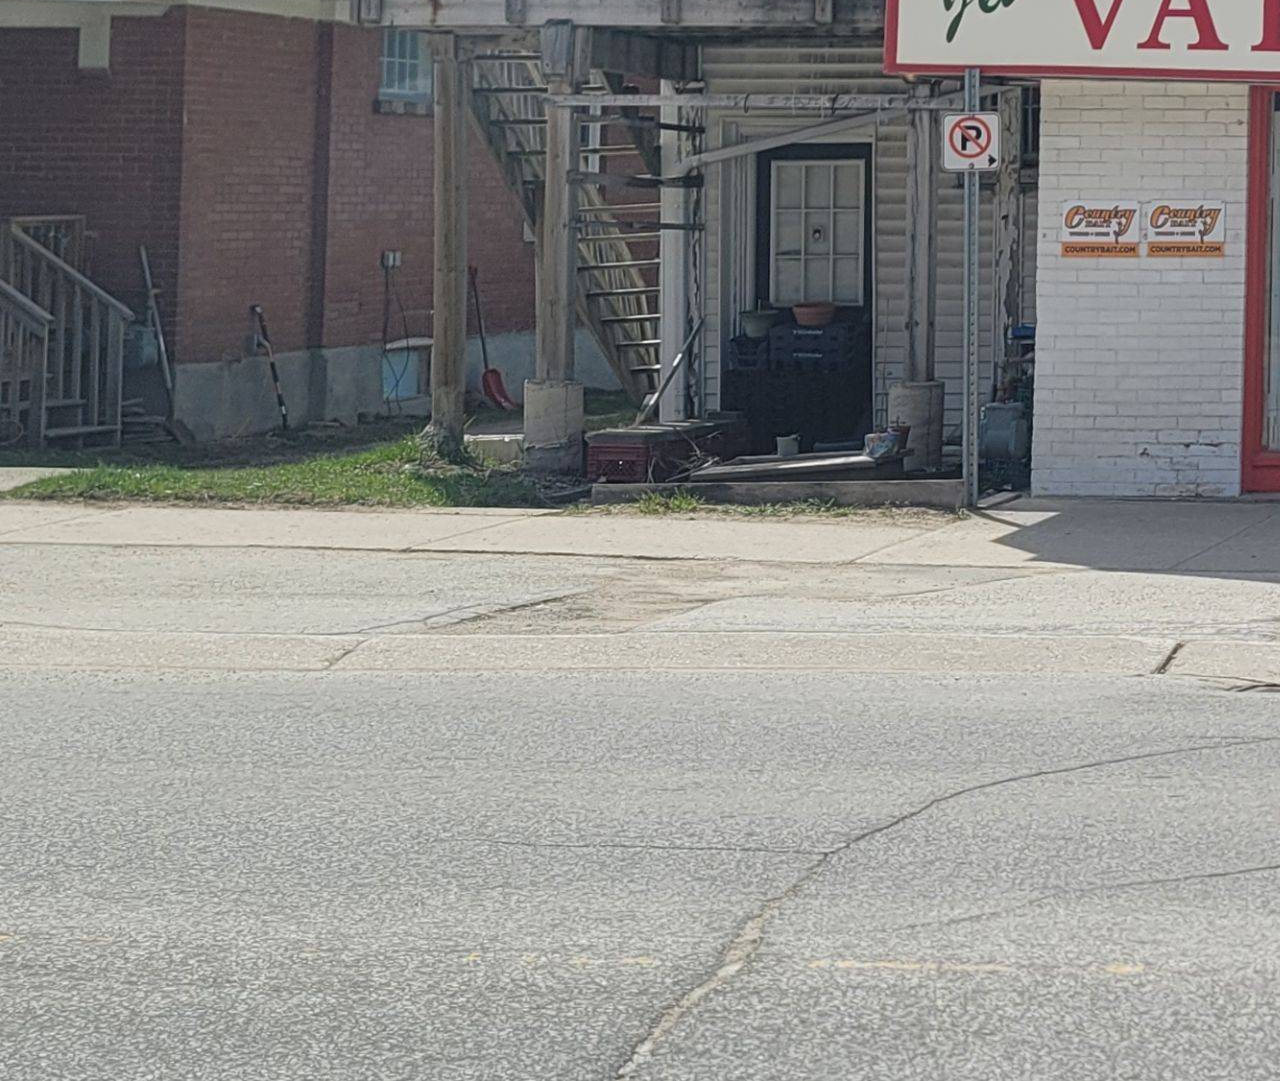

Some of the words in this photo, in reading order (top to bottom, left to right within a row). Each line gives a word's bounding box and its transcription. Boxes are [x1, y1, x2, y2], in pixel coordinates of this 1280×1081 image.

[960, 125, 983, 151] P
[1065, 205, 1137, 237] Country
[1150, 205, 1222, 237] Country
